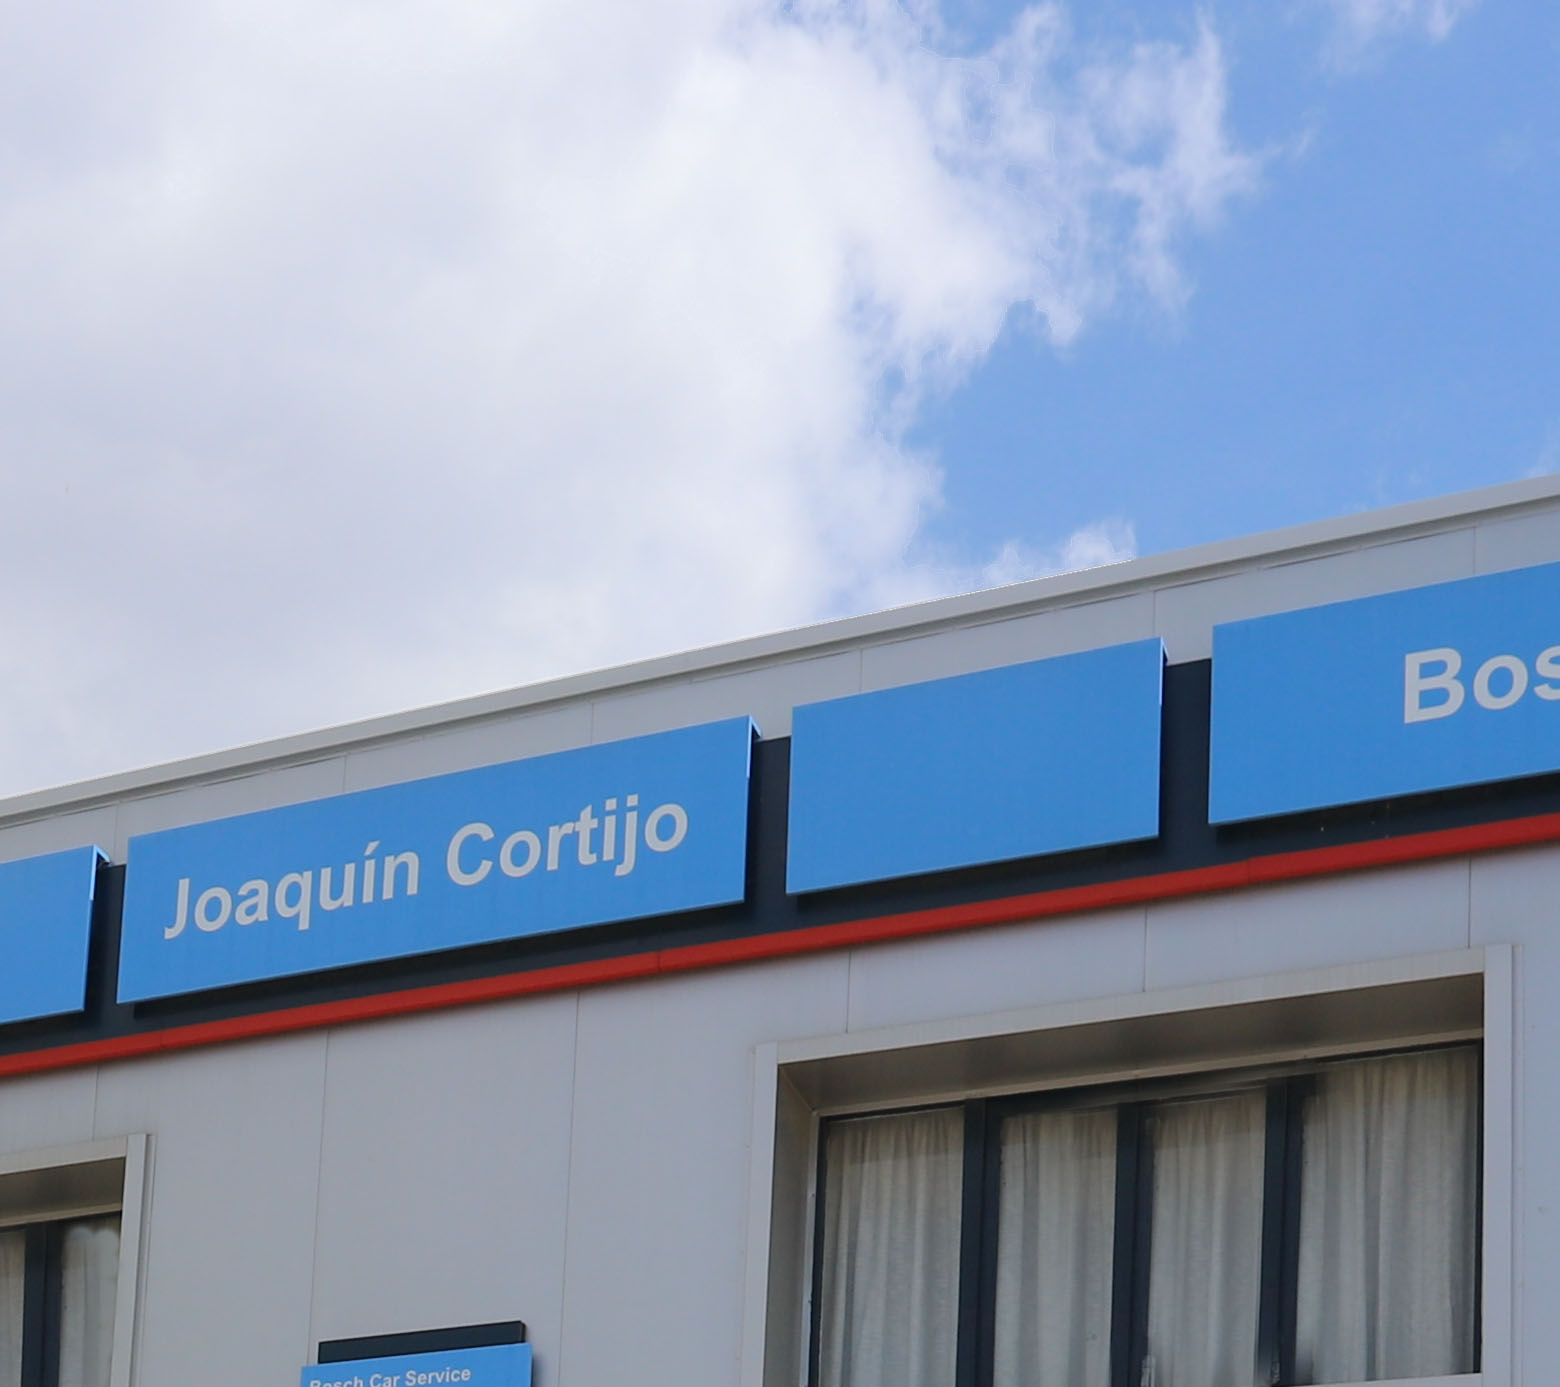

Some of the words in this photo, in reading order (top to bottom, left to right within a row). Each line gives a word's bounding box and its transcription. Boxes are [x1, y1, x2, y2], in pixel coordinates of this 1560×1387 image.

[164, 840, 420, 940] Joaquín
[446, 794, 688, 886] Cortijo
[405, 1367, 471, 1386] Service
